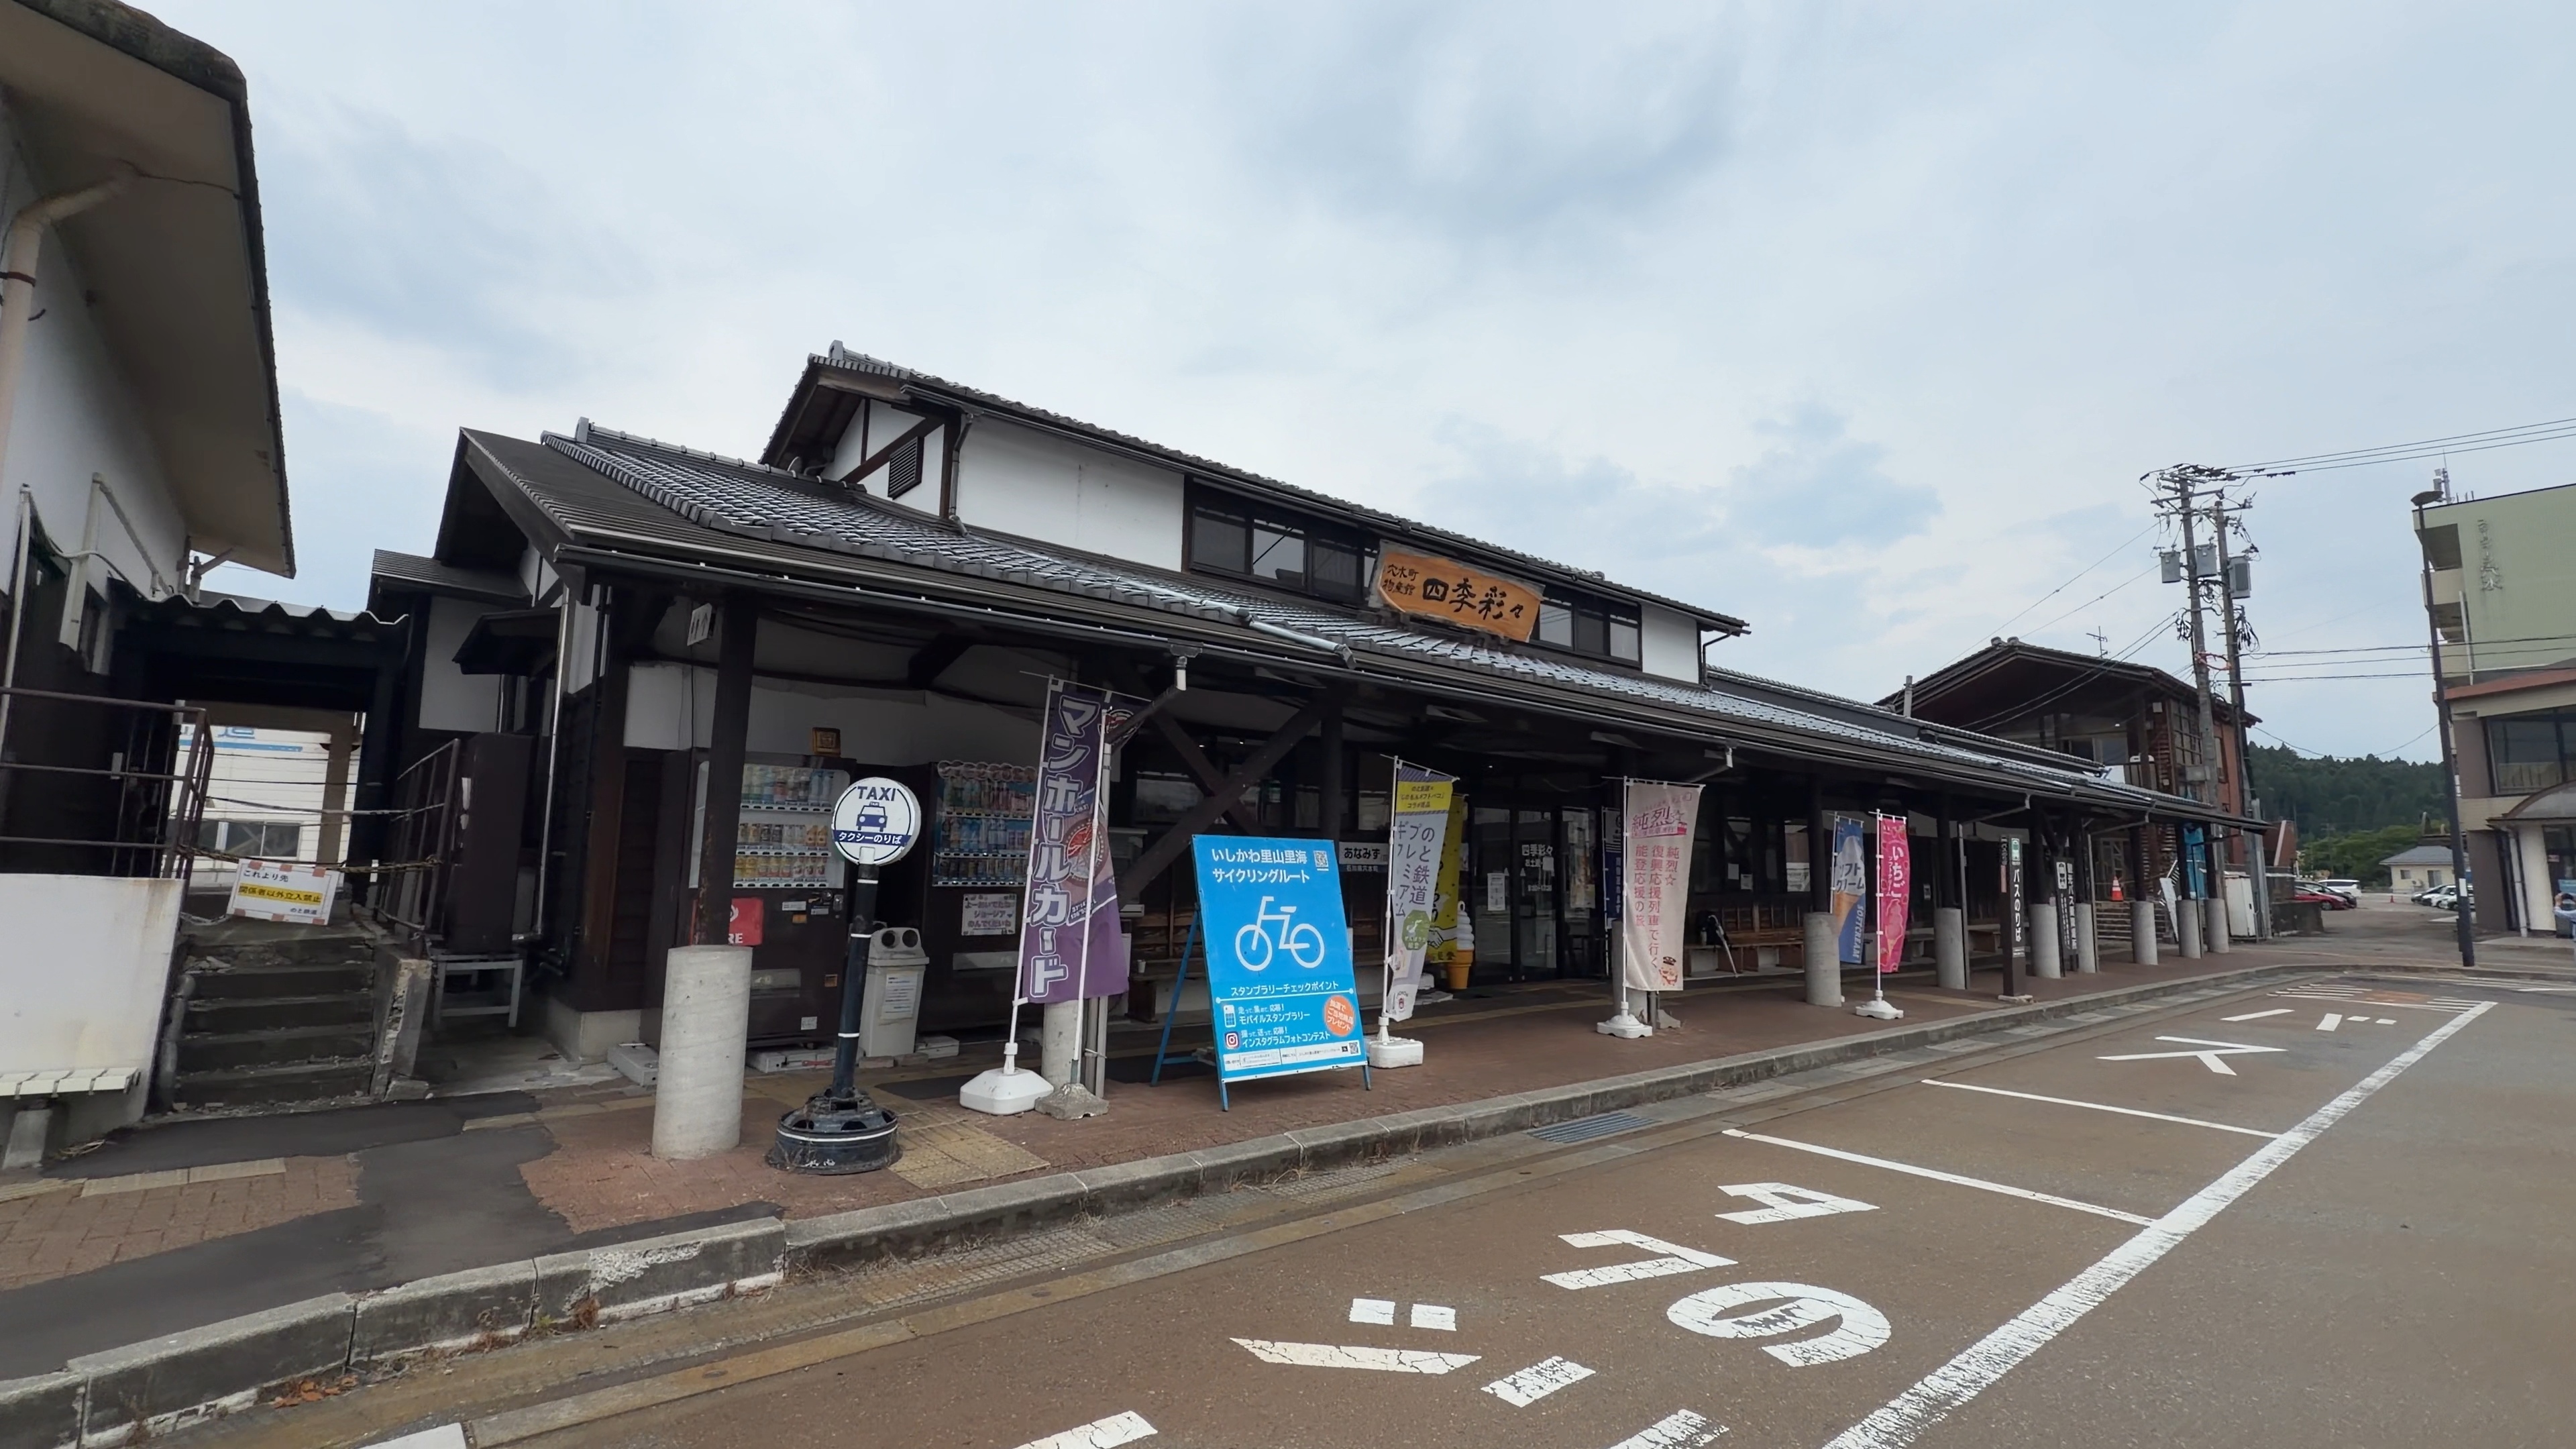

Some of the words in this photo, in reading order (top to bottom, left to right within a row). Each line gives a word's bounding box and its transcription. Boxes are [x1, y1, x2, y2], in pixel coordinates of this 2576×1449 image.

[1387, 564, 1419, 581] 穴水町
[1382, 579, 1416, 596] 物産館
[1422, 578, 1523, 621] 四季彩々
[857, 786, 896, 802] TAXI
[839, 832, 903, 845] タクシーのりば
[1029, 695, 1101, 998] マンホールカード
[1212, 848, 1307, 865] いしかわ里山里海
[1395, 823, 1422, 917] プレミアム
[1409, 827, 1435, 905] のと鉄道
[1891, 846, 1905, 898] いちご
[243, 870, 289, 882] これより先
[1212, 868, 1310, 883] サイクリングルート
[238, 885, 321, 903] 関係者以外立入禁止
[1634, 845, 1648, 927] 能登応援の旅
[1648, 845, 1664, 969] 復興応援列車で行く
[2013, 868, 2022, 943] バスのりば
[1231, 981, 1339, 996] スタンプラリーチェックポイント
[1239, 1012, 1310, 1024] モバイルスタンプラリー
[1327, 1016, 1351, 1031] プレゼント
[1242, 1031, 1331, 1048] インスタグラムフォトコンテスト
